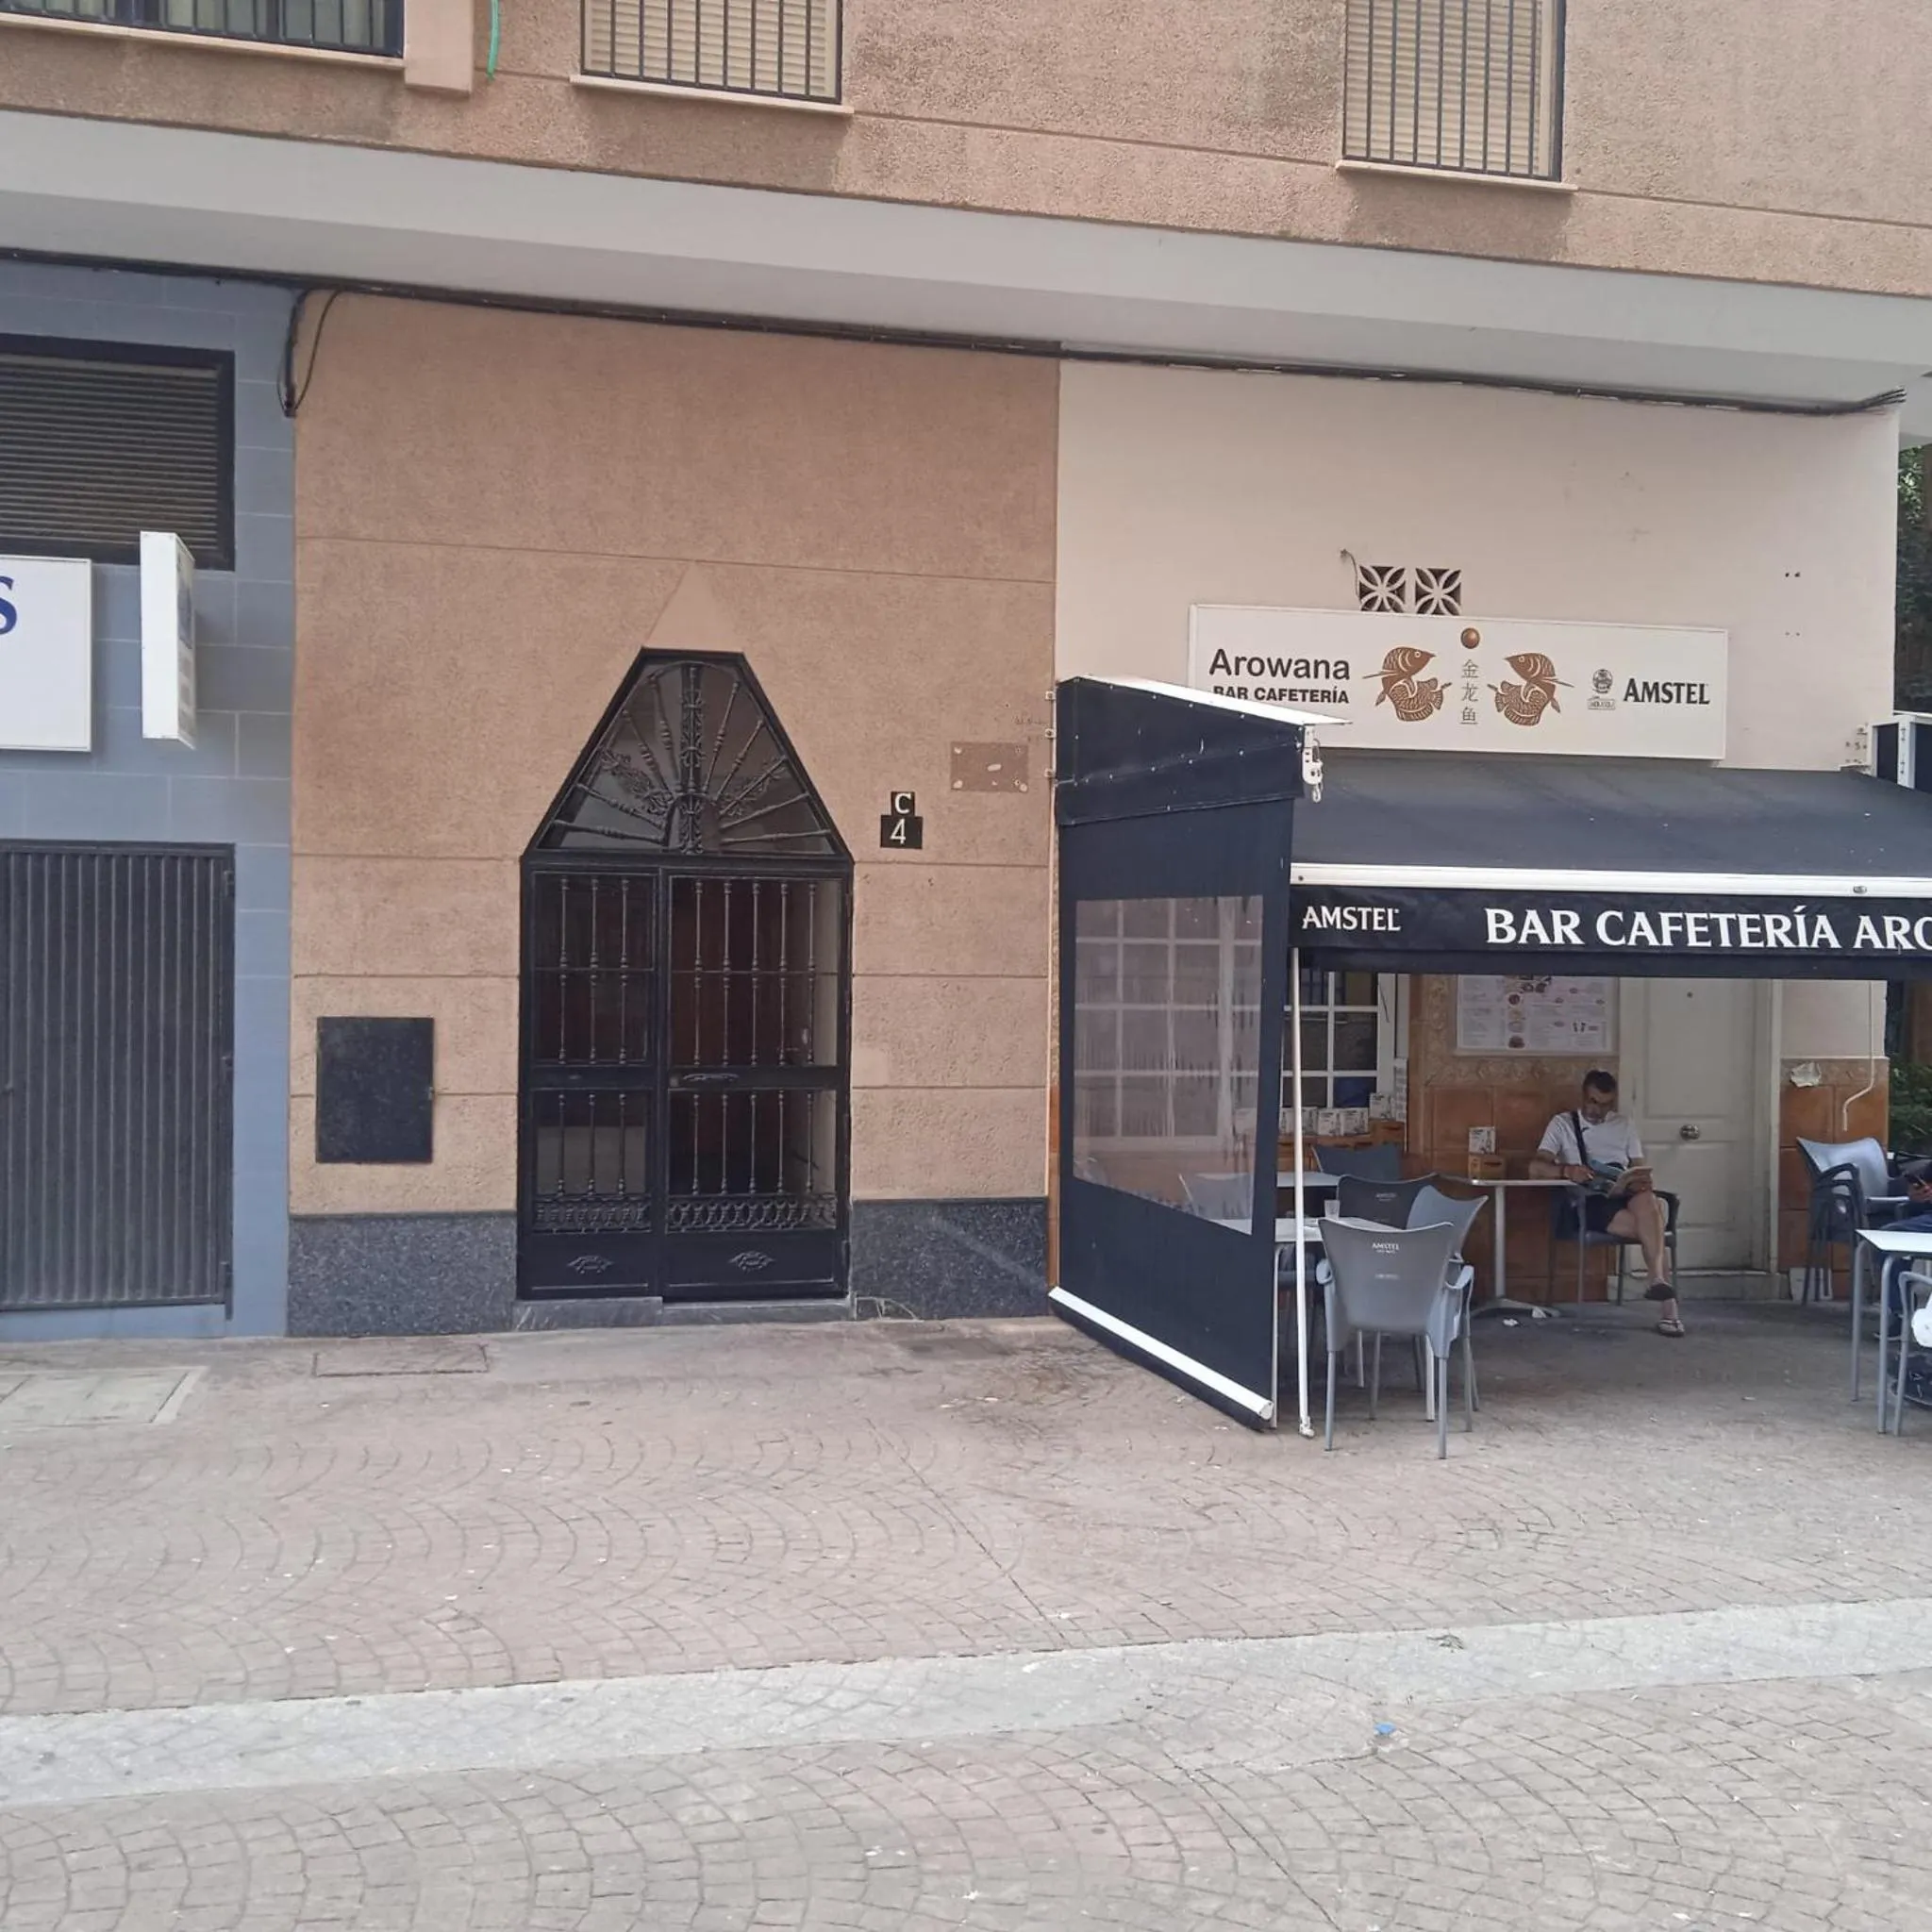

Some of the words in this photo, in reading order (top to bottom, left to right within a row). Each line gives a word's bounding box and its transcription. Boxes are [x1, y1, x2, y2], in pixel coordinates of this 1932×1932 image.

[1208, 648, 1351, 680] Arowana
[1213, 685, 1249, 700] BAR
[1254, 686, 1350, 704] CAFETERÍA
[1459, 658, 1479, 725] 金龙鱼
[1623, 677, 1711, 706] AMSTEL
[894, 793, 911, 813] C
[890, 818, 907, 844] 4
[1302, 906, 1401, 931] AMSTEL
[1484, 908, 1586, 945] BAR
[1595, 905, 1841, 949] CAFETERÍA
